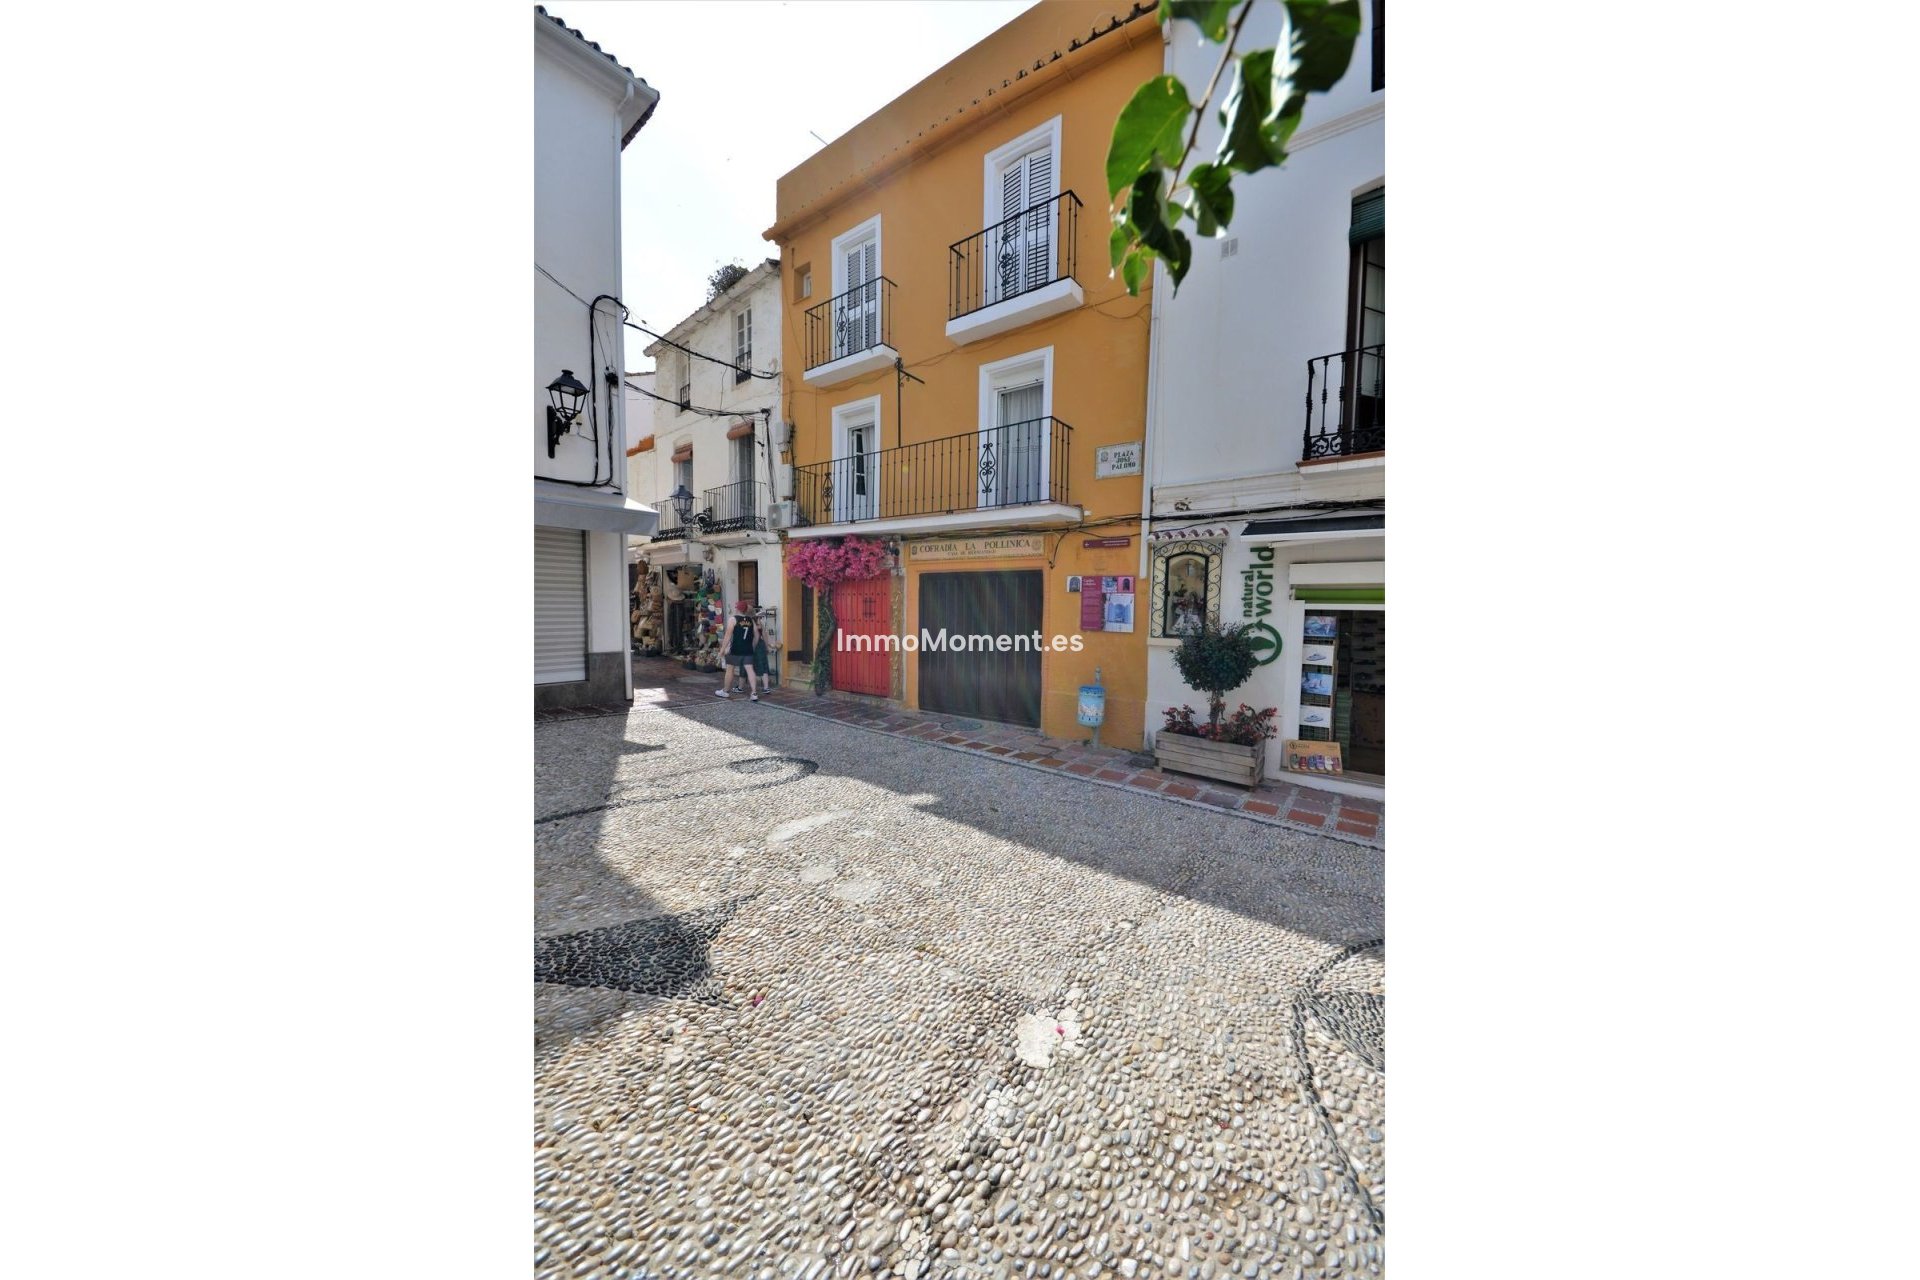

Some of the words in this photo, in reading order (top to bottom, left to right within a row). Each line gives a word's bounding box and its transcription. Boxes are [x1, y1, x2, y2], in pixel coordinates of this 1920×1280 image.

[1114, 450, 1134, 458] PLAZA
[1111, 462, 1136, 470] PALOMO
[965, 542, 975, 550] LA
[984, 539, 1030, 550] POLLINICA
[1249, 547, 1275, 618] world
[1240, 570, 1254, 618] natural
[743, 626, 749, 640] 7
